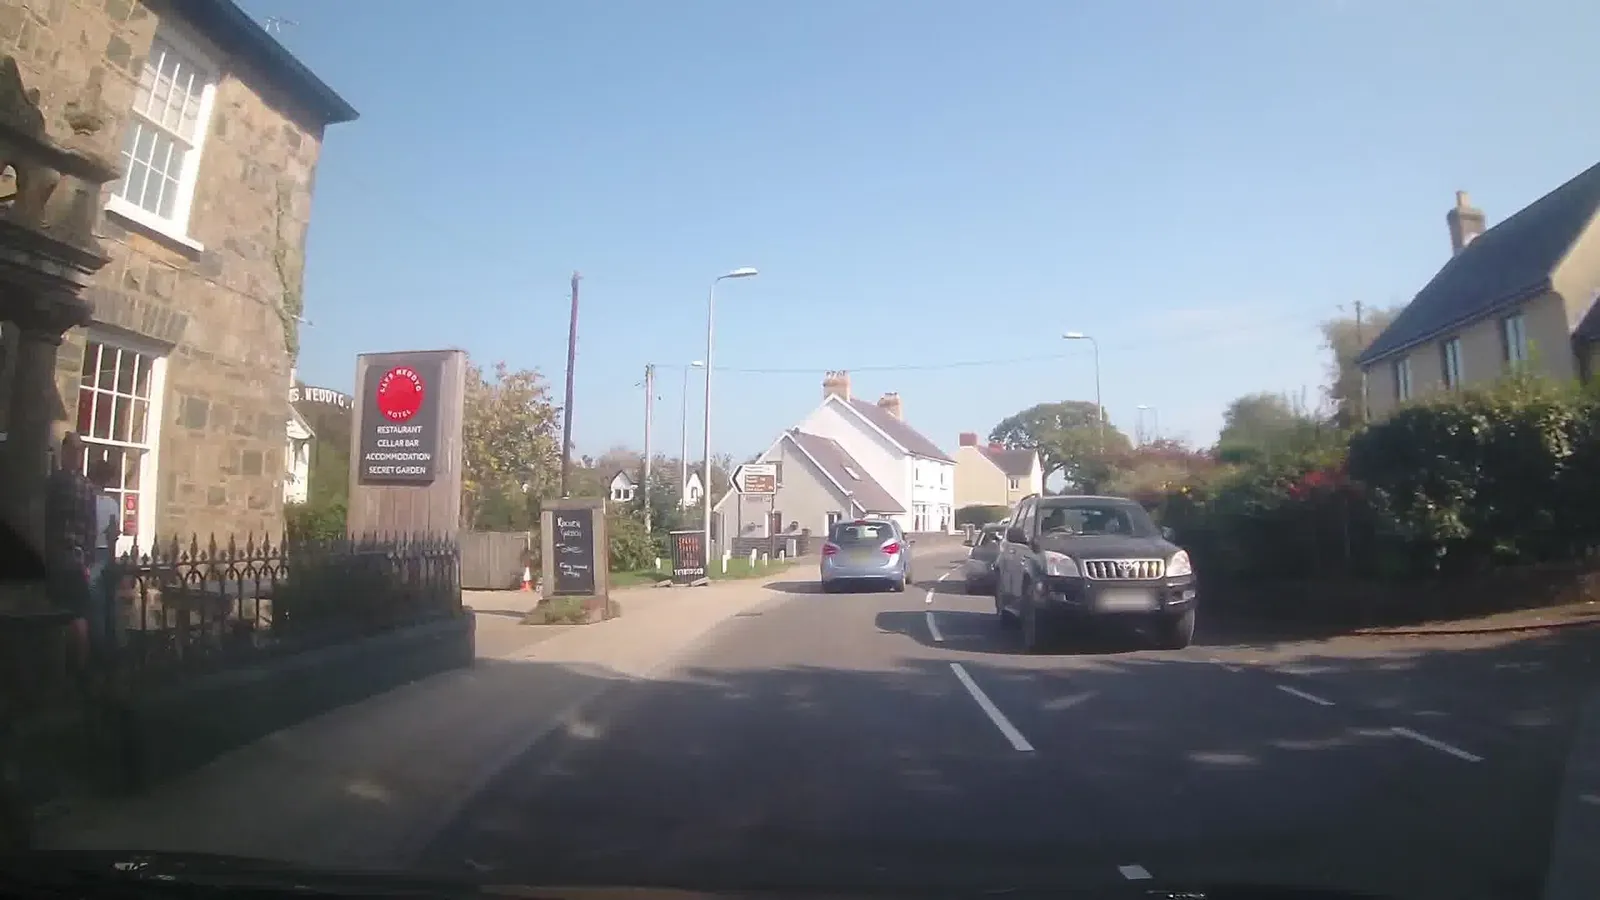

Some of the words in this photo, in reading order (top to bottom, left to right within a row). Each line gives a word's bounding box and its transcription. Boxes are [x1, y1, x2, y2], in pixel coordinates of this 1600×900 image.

[387, 409, 412, 419] HOTEL
[377, 425, 423, 434] RESTAURANT
[377, 439, 404, 447] CELLAR
[405, 439, 419, 447] BAR
[365, 452, 431, 461] ACCOMMODATION
[369, 466, 395, 474] SECRET
[396, 466, 426, 474] GARDEN
